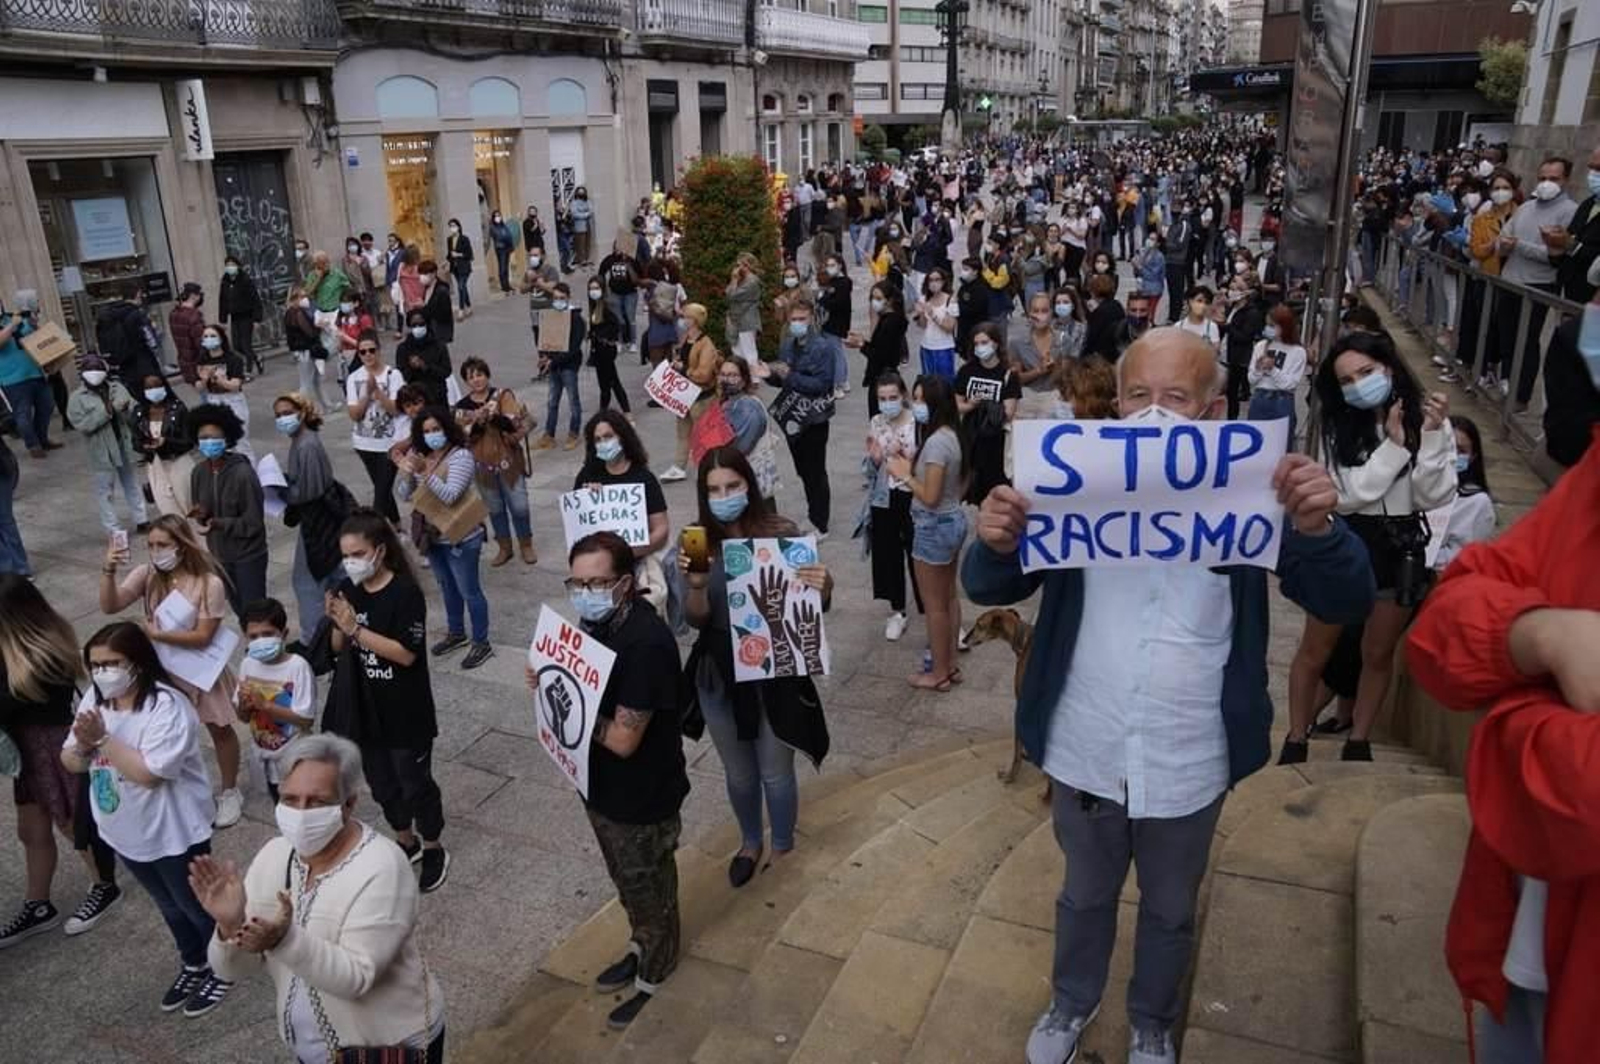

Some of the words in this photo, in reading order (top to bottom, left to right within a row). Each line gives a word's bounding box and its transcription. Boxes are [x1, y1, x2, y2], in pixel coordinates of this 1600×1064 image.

[662, 366, 690, 393] VIGO
[1034, 423, 1264, 496] STOP
[563, 491, 581, 512] AS
[589, 485, 643, 507] VIDAS
[578, 507, 639, 526] NEGRAS
[1018, 511, 1274, 567] RACISMO
[766, 587, 784, 622] LIVES
[559, 622, 583, 651] NO
[797, 620, 823, 676] MATTER
[535, 633, 601, 692] JUSTCIA
